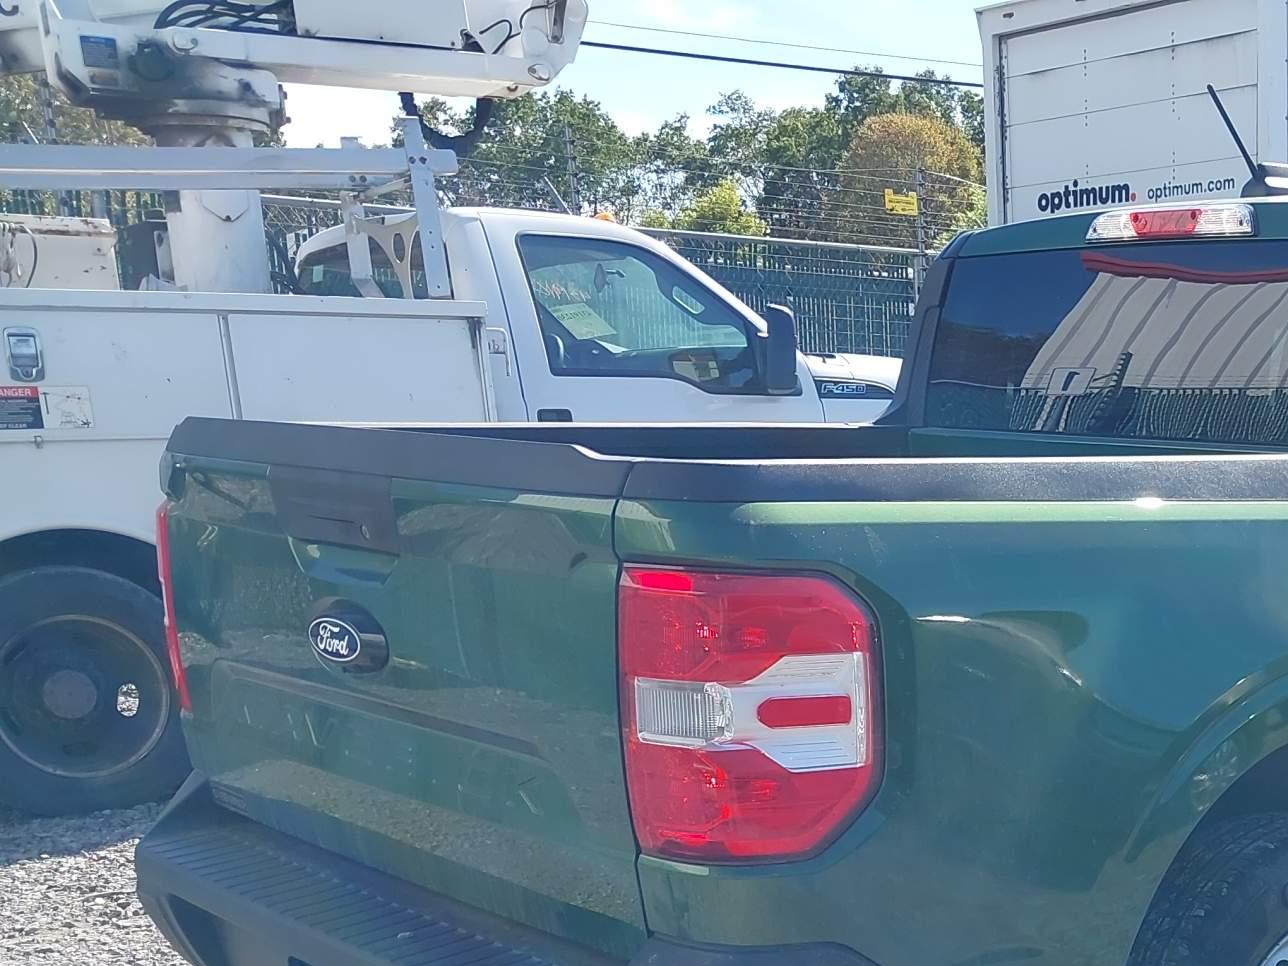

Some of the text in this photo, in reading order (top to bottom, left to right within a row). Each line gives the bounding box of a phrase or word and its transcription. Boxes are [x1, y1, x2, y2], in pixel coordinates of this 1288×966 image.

[1147, 177, 1235, 203] optimum.com
[821, 383, 866, 393] F-450
[317, 623, 350, 656] Ford
